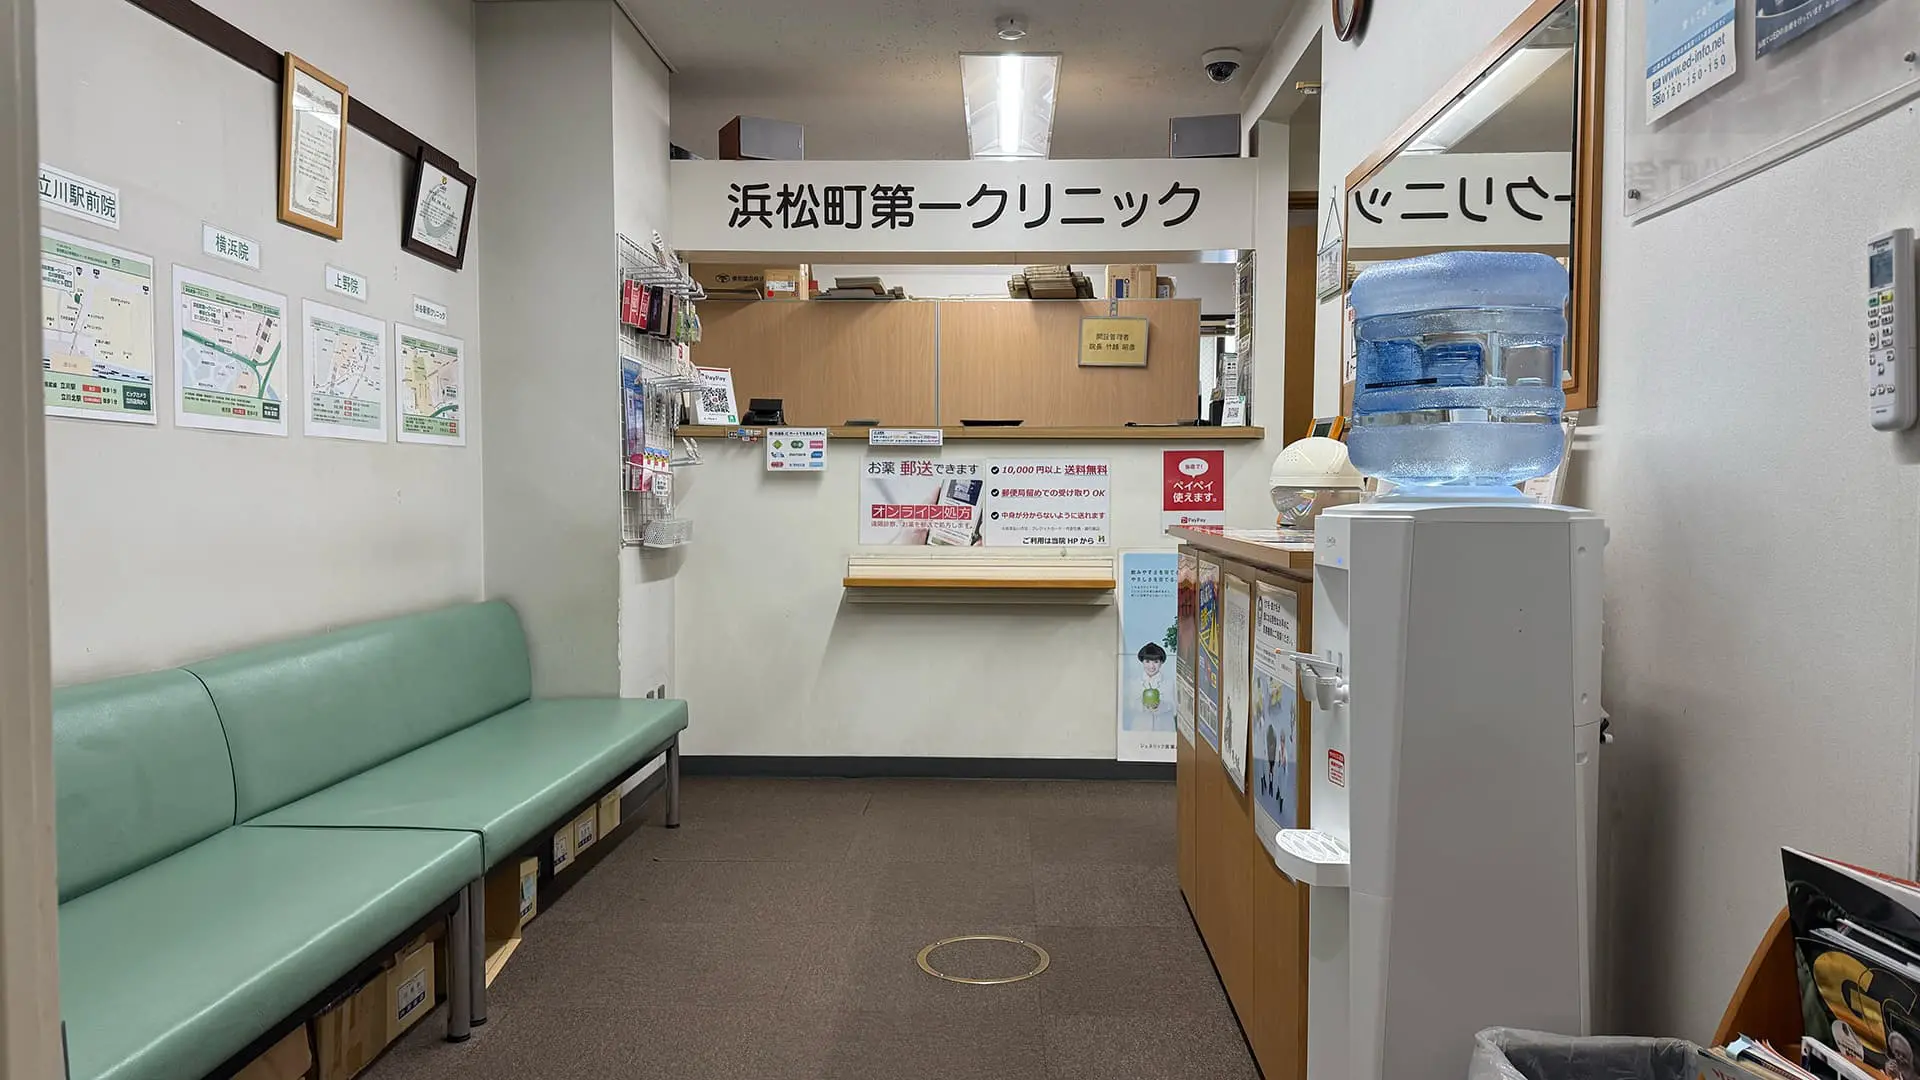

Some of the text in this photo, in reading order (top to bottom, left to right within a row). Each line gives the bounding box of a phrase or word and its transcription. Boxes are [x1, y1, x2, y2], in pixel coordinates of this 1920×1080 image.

[1662, 32, 1725, 84] www.ed-info.net
[1661, 54, 1726, 103] 0120-150-150
[40, 174, 115, 217] 立川駅前院
[727, 182, 1201, 229] 浜松町第一クリニック
[215, 233, 249, 261] 横浜院
[334, 273, 359, 294] 上野院
[868, 460, 979, 476] お薬 郵送できます
[1002, 464, 1108, 475] 10,000 円以上 送料無料
[1092, 489, 1106, 497] OK
[1173, 480, 1213, 491] ペイペイ
[1173, 492, 1217, 503] 使えます。
[872, 505, 972, 519] オンライン処方
[1001, 511, 1105, 519] 中身が分からないように送れます
[1022, 537, 1066, 545] ご利用は当院
